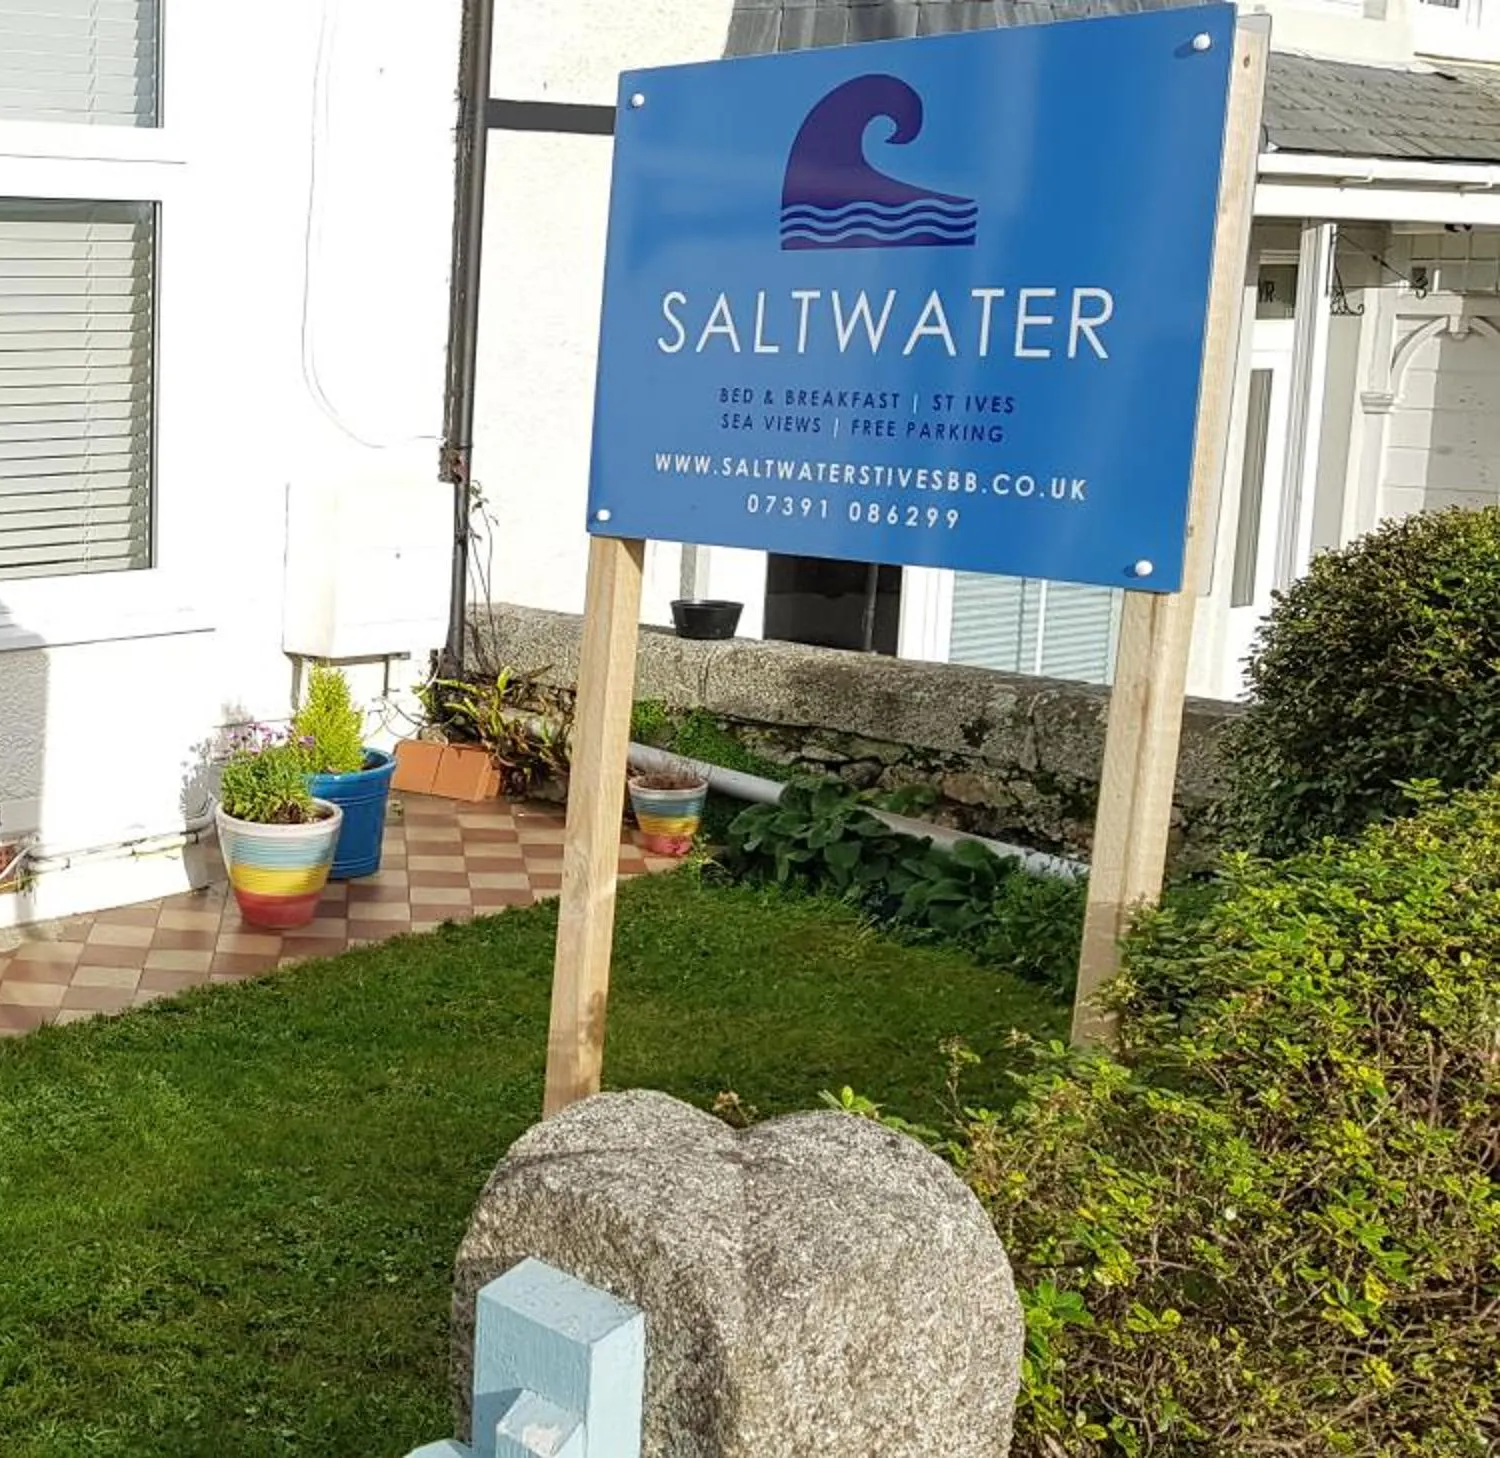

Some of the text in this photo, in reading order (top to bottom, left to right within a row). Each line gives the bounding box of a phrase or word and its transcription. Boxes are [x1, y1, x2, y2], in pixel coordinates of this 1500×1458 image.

[657, 287, 1114, 360] SALTWATER
[718, 387, 1016, 414] BED & BREAKFAST ST IVES
[720, 412, 1005, 443] SEA VIEWS FREE PARKING
[654, 452, 1088, 501] WWW.SALTWATERSTIVESBB.CO.UK
[747, 493, 961, 529] 07391 086299
